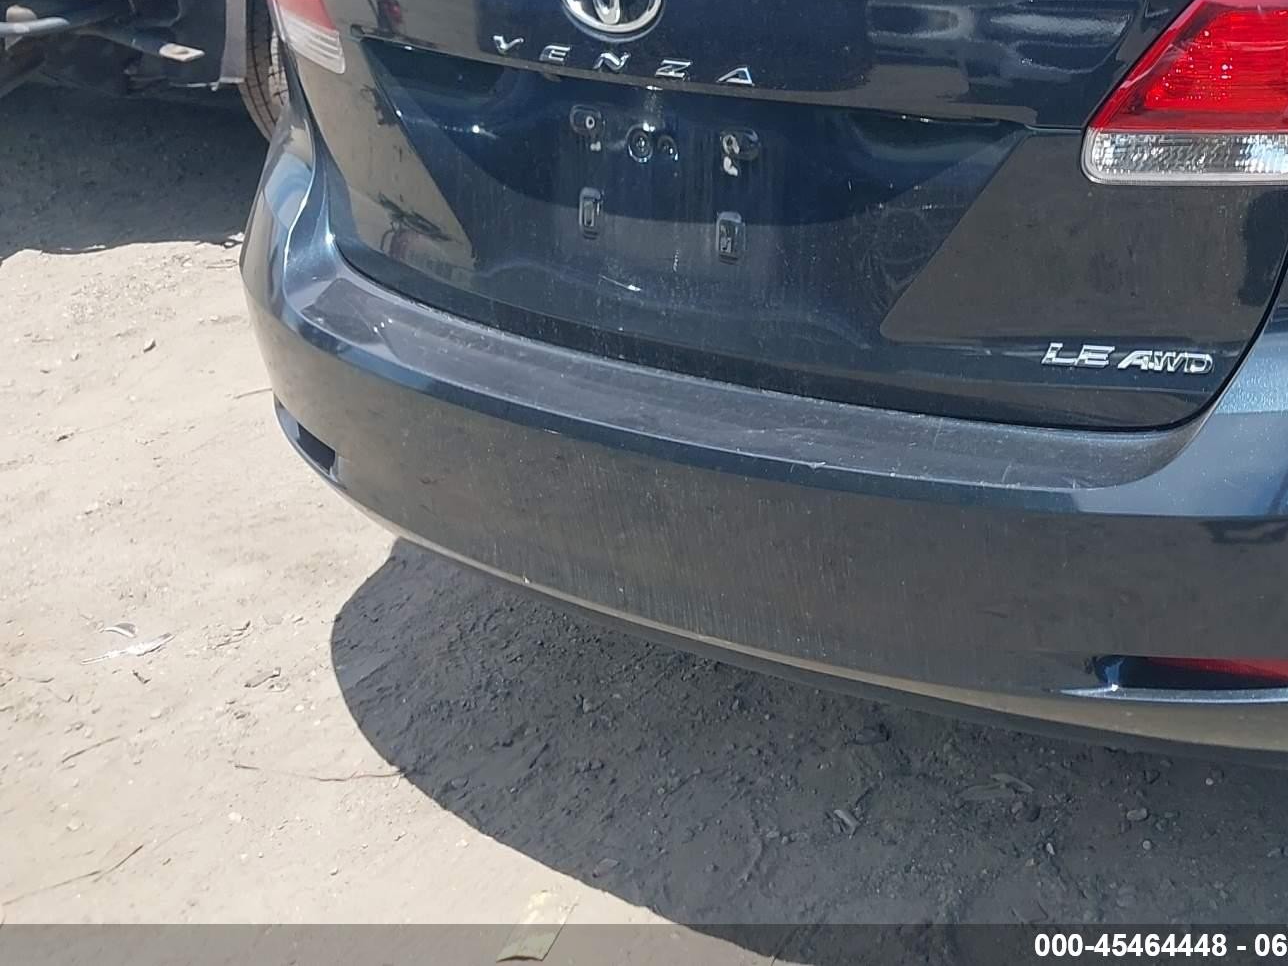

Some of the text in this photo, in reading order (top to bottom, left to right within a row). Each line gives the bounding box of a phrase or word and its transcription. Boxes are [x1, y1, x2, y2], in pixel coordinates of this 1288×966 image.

[492, 34, 755, 86] VENZA
[1040, 342, 1215, 374] LE AWD
